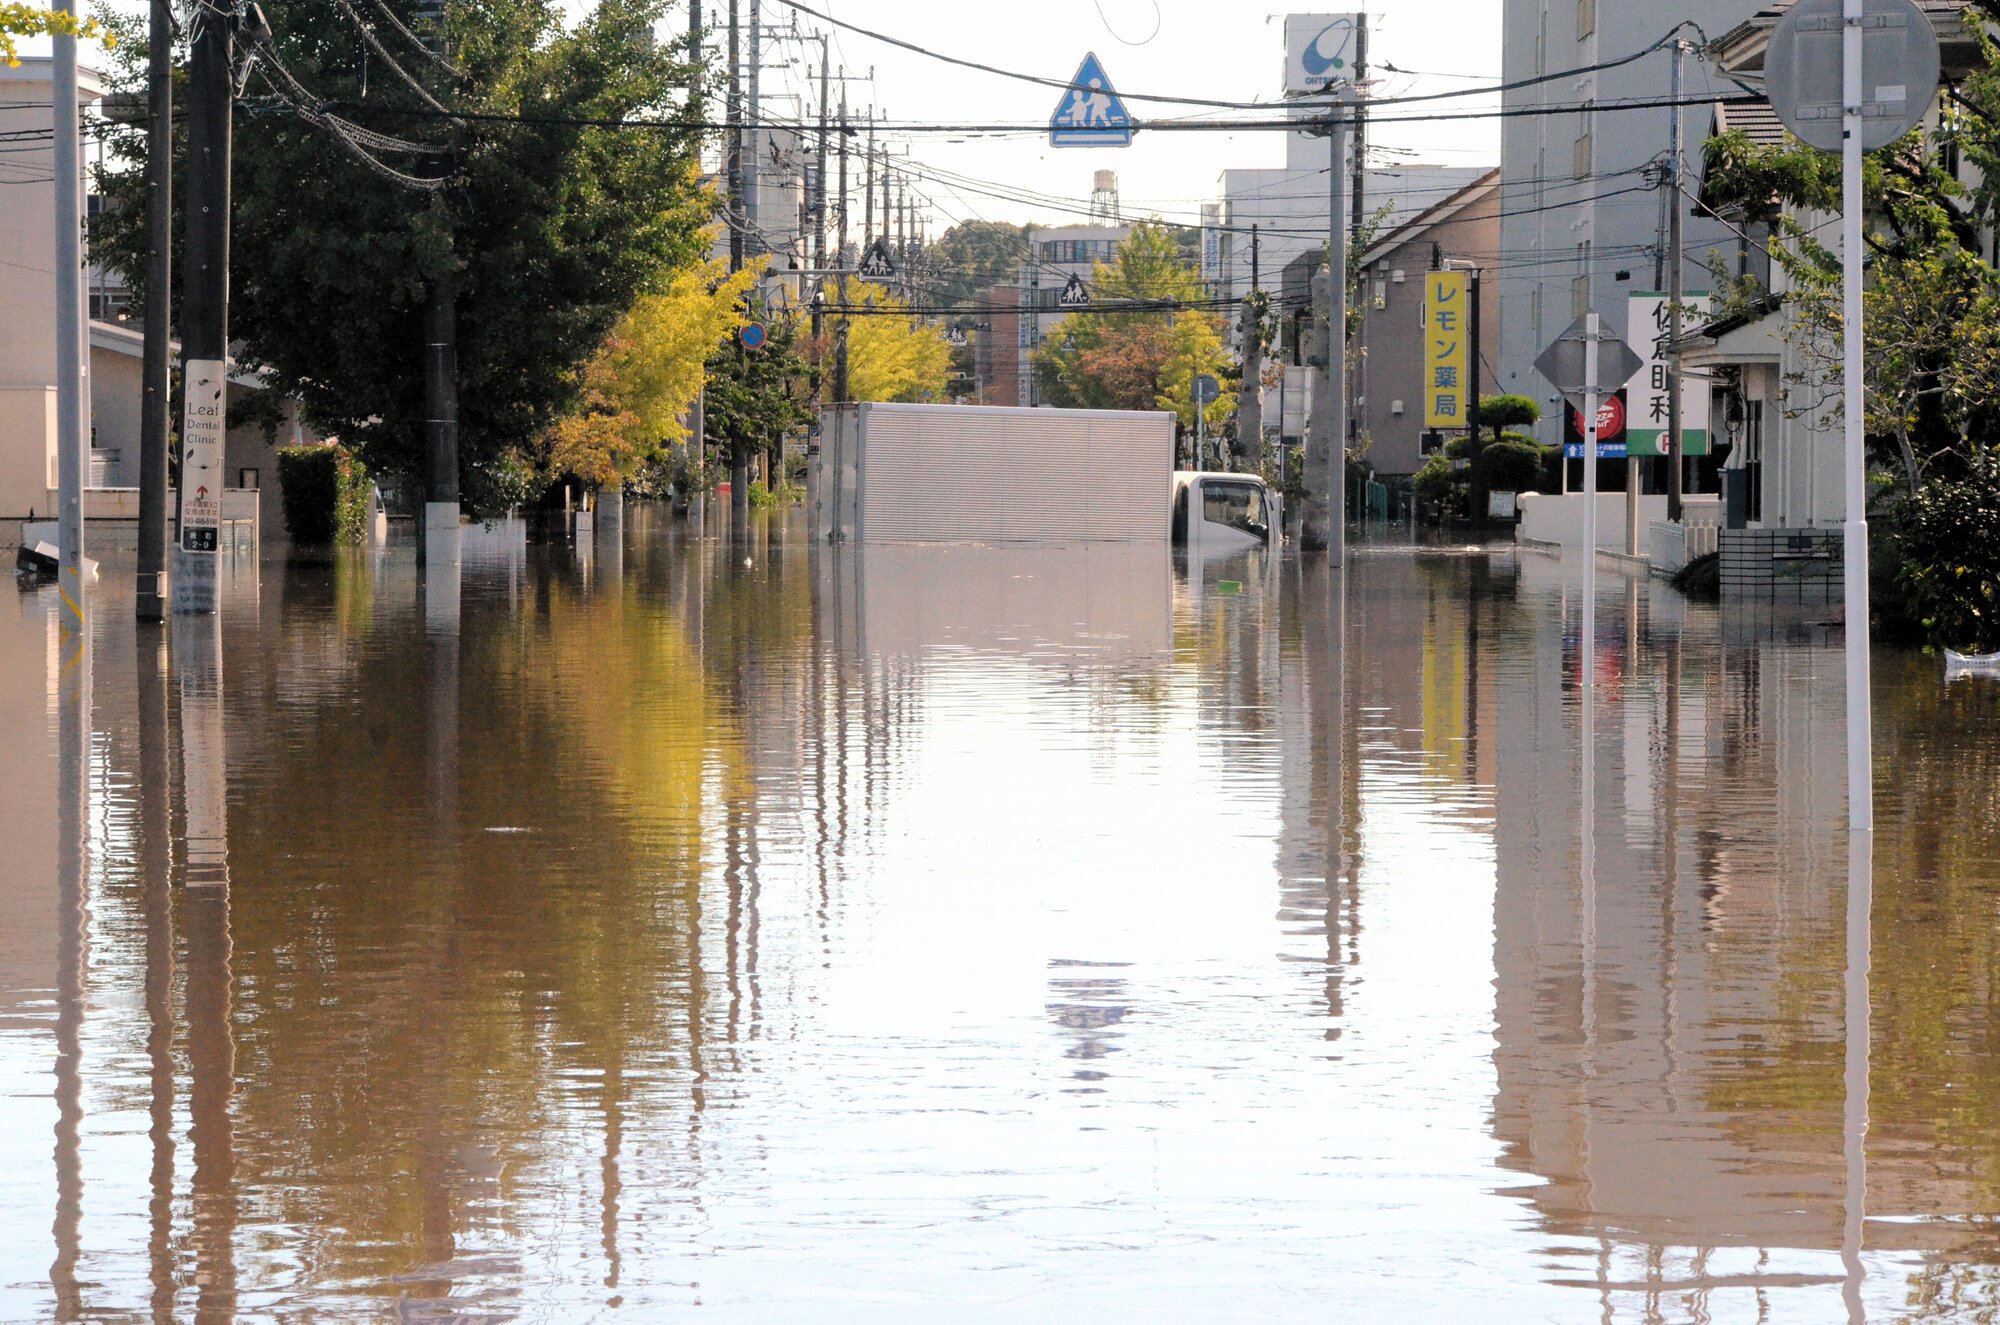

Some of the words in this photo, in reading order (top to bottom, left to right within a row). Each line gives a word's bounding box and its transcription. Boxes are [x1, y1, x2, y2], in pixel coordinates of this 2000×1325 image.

[1435, 282, 1457, 416] レモン薬局
[188, 401, 220, 416] Leaf
[187, 419, 220, 430] Dental
[186, 433, 217, 444] Clinic
[192, 541, 209, 549] 2-9
